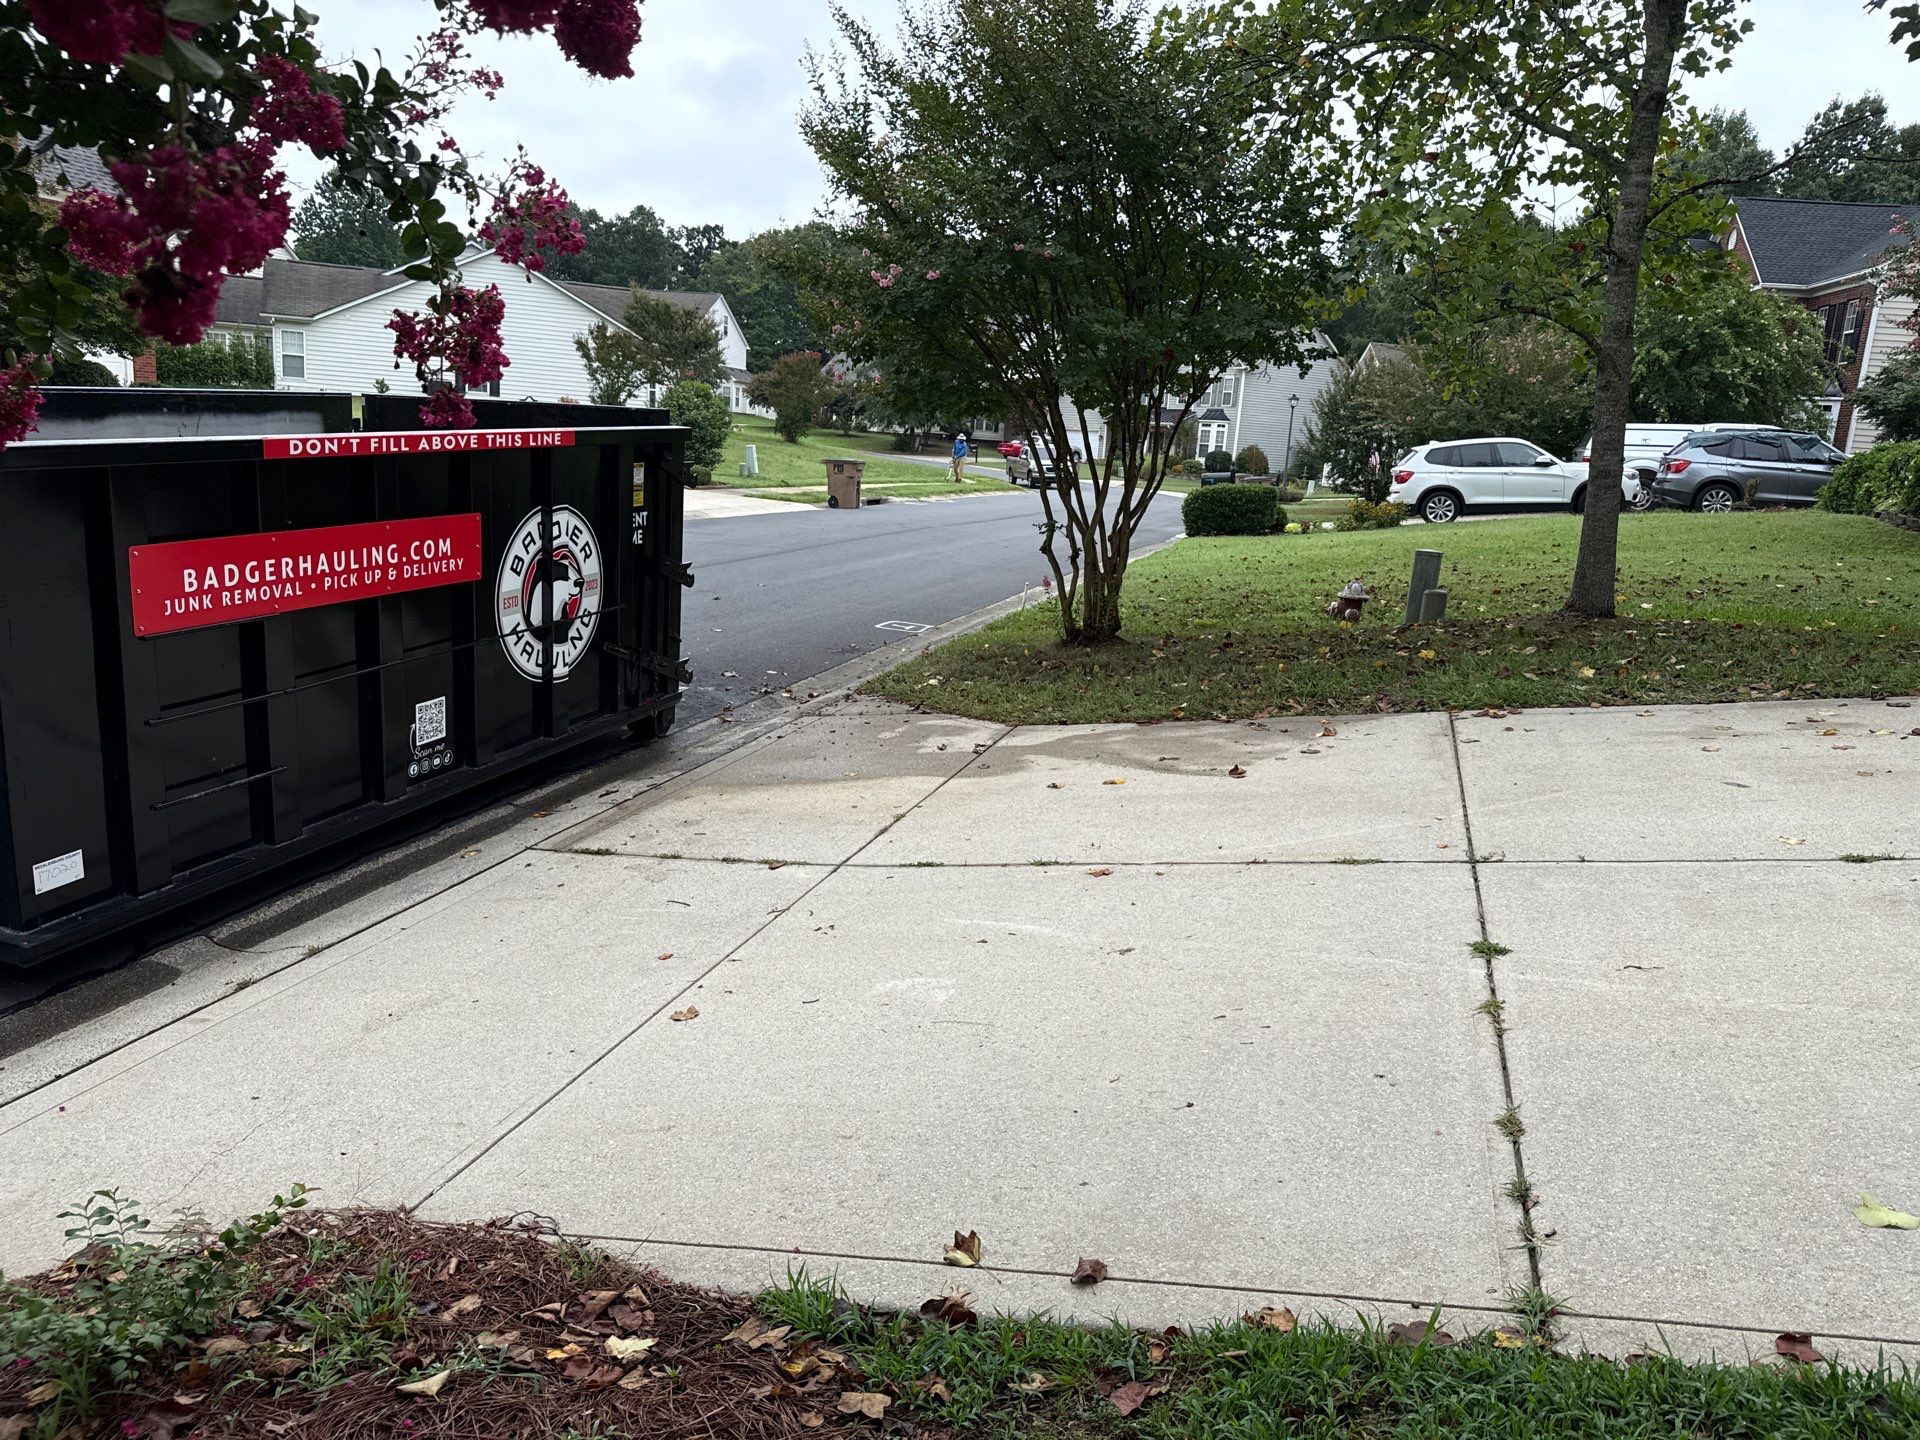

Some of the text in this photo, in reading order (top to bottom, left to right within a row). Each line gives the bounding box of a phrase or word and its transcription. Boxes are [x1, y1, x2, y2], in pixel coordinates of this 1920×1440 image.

[289, 432, 562, 455] DON'T FILL ABOVE THIS LINE
[183, 537, 452, 593] BADGERHAULING.COM
[509, 519, 593, 577] BADER
[164, 558, 464, 616] JUNK REMOVAL PICK UP & DELIVERY
[503, 578, 599, 610] ESTD 2023
[508, 608, 593, 669] HAULNG
[414, 743, 446, 760] Scan me
